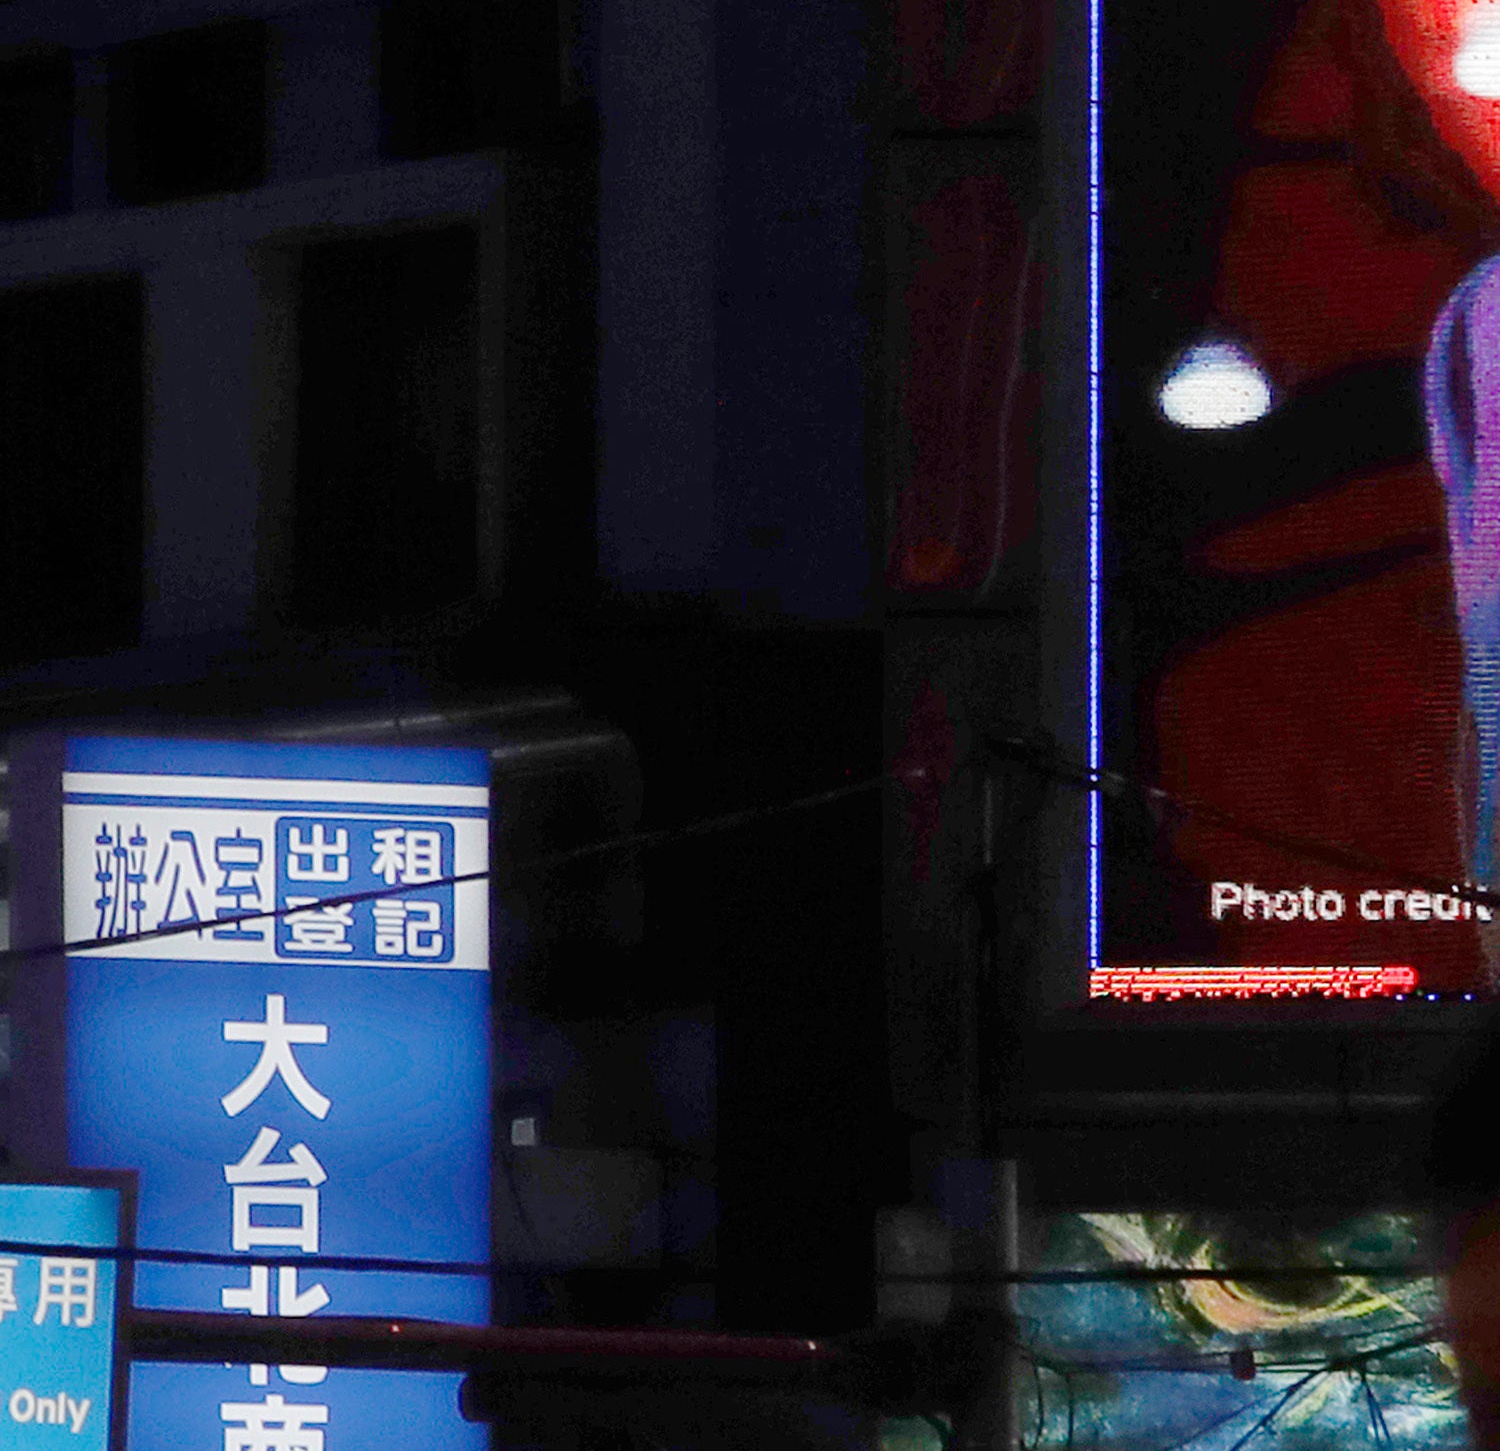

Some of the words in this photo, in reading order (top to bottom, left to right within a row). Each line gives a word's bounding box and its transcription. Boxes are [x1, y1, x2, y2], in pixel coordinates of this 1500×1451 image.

[95, 822, 264, 941] 辦公室
[287, 824, 442, 886] 出租
[283, 895, 444, 959] 登記
[1211, 882, 1346, 922] Photo
[9, 1388, 90, 1434] Only
